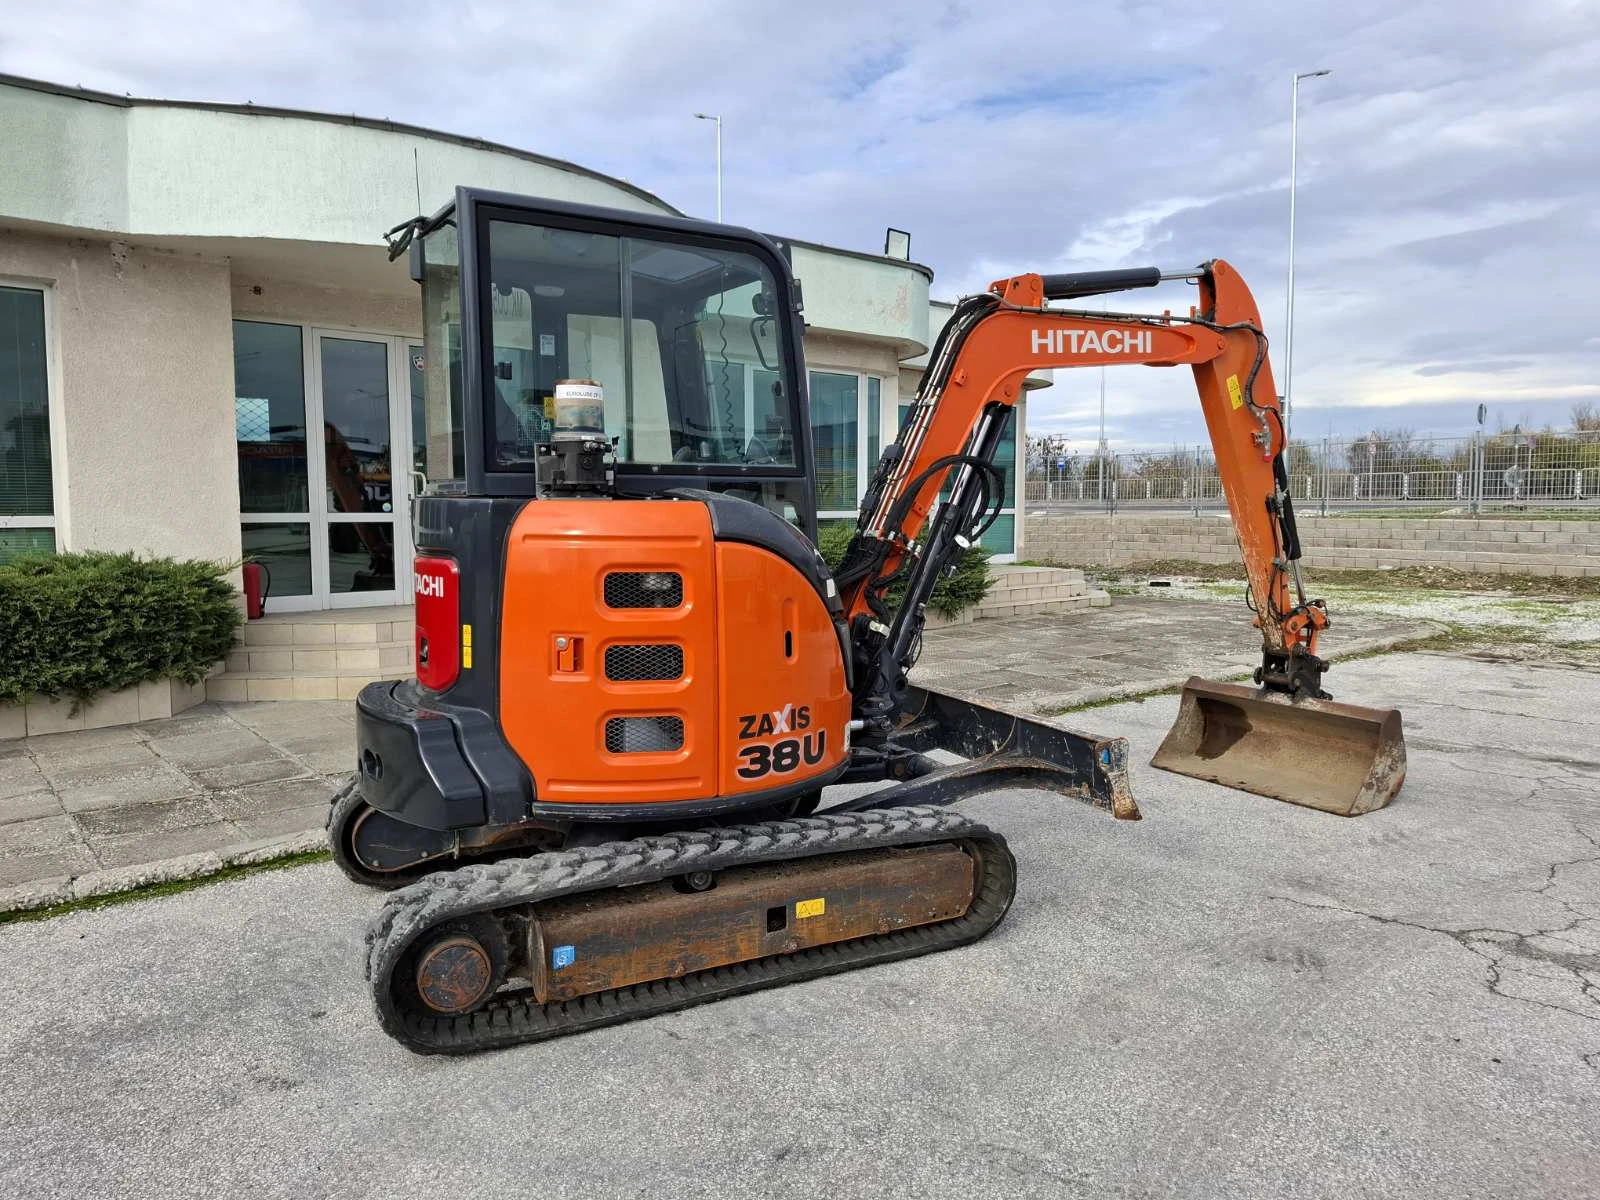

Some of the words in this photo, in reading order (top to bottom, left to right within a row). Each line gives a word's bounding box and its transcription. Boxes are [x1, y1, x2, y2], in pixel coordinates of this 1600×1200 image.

[1031, 329, 1152, 354] HITACHI
[738, 703, 811, 740] ZAXIS
[737, 729, 826, 779] 38U
